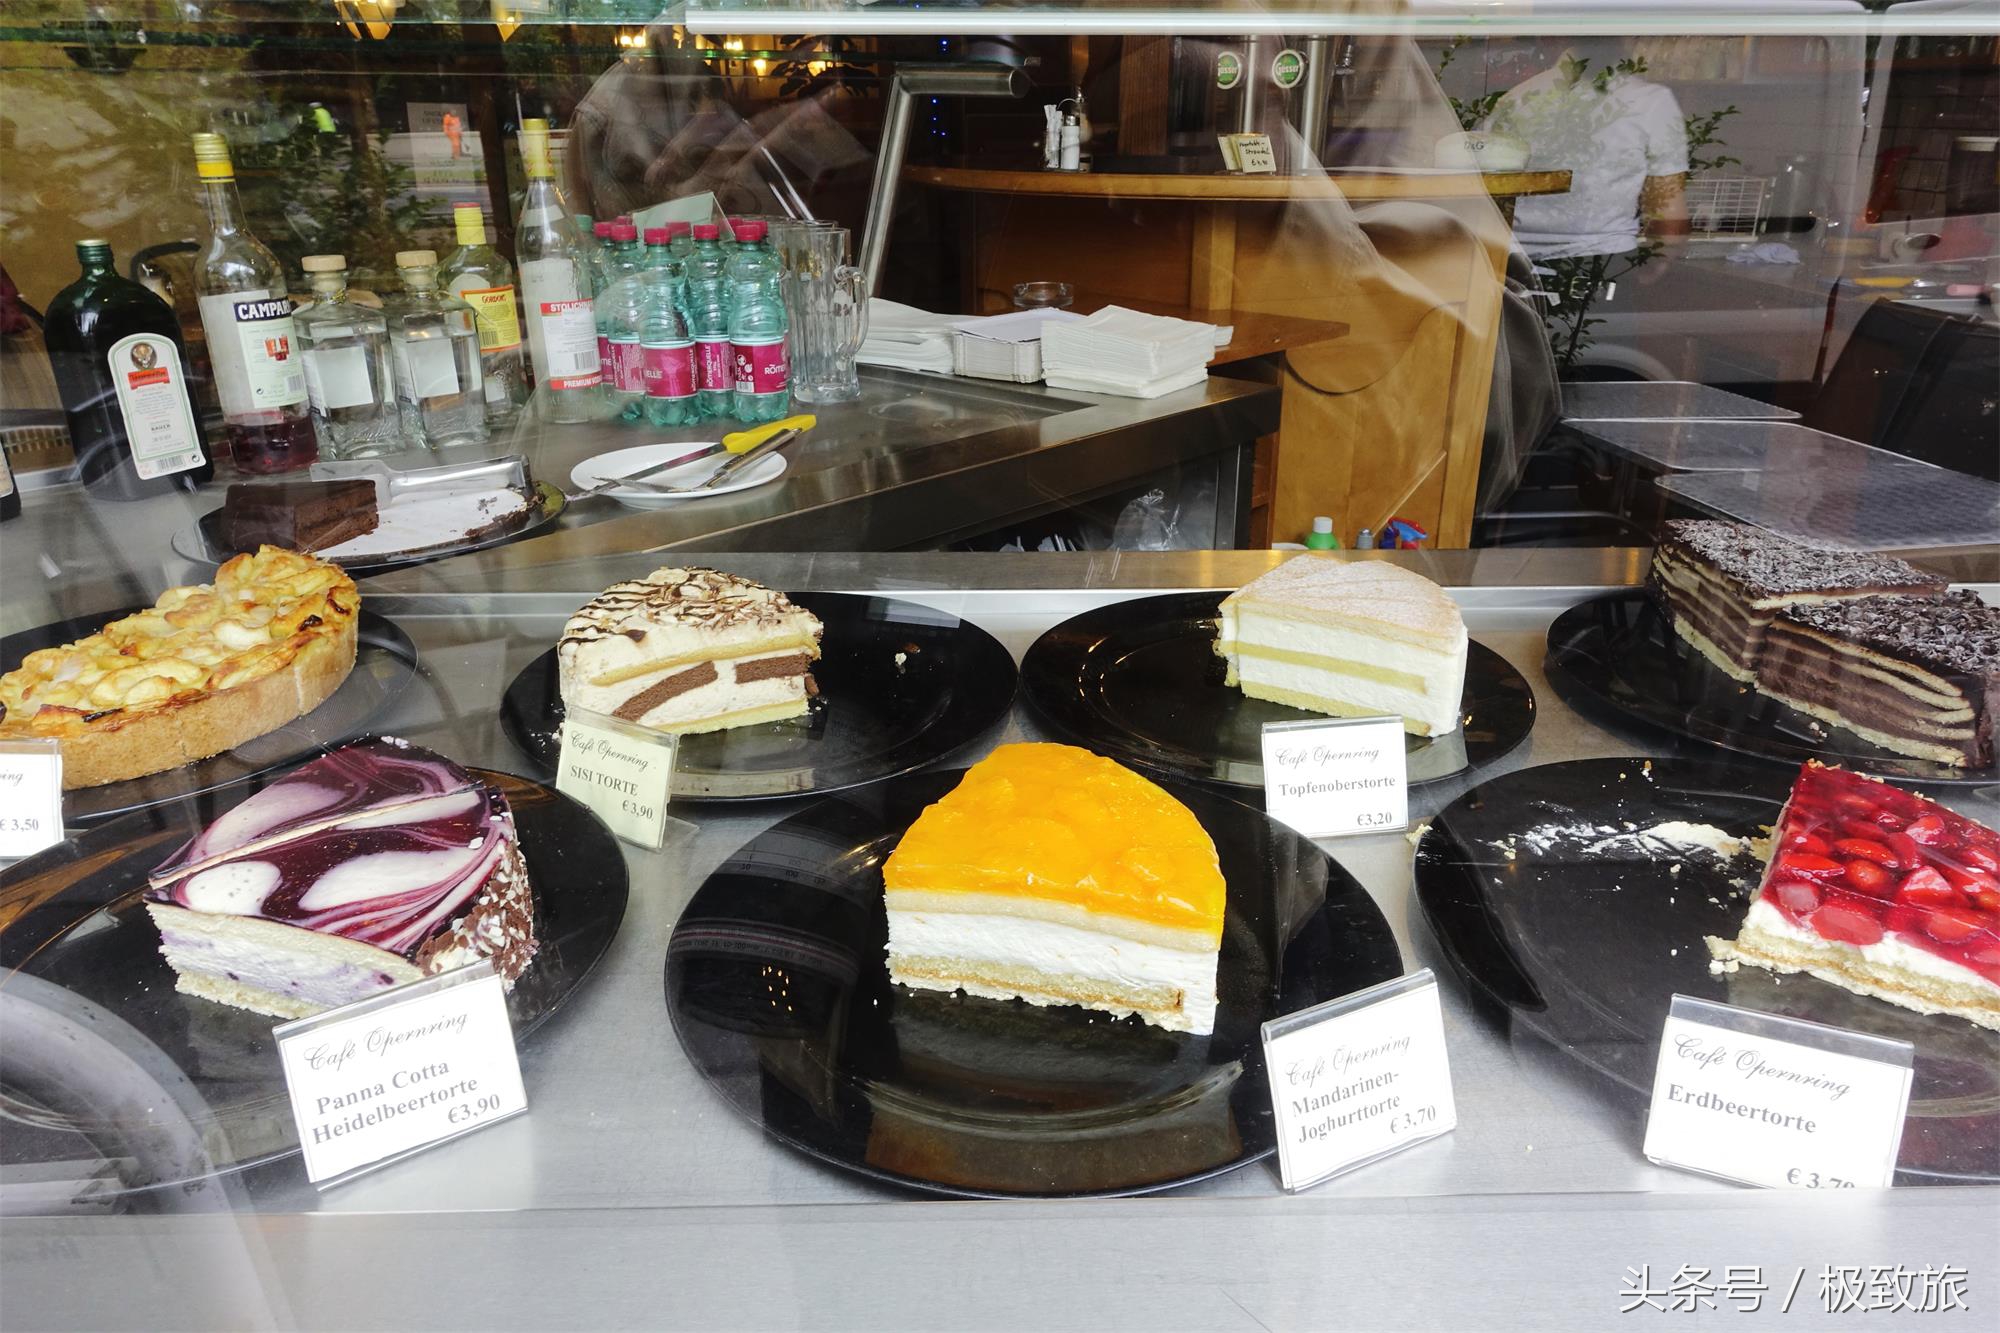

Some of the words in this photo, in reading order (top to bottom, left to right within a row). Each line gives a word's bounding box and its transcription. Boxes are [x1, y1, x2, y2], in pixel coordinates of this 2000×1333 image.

[570, 764, 593, 782] SISI
[596, 772, 639, 797] TORTE
[1278, 776, 1396, 798] Topfenoberstorte
[303, 1040, 357, 1072] Café
[366, 1013, 468, 1057] Opernring
[1673, 1033, 1726, 1070] Café
[1735, 1049, 1852, 1101] Opernring
[312, 1078, 479, 1145] Heidelbeertorte
[315, 1083, 386, 1116] Panna
[391, 1061, 450, 1090] Cotta
[1292, 1070, 1400, 1118] Mandarinen-
[1667, 1083, 1818, 1134] Erdbeertorte
[1298, 1095, 1400, 1144] Joghurttorte
